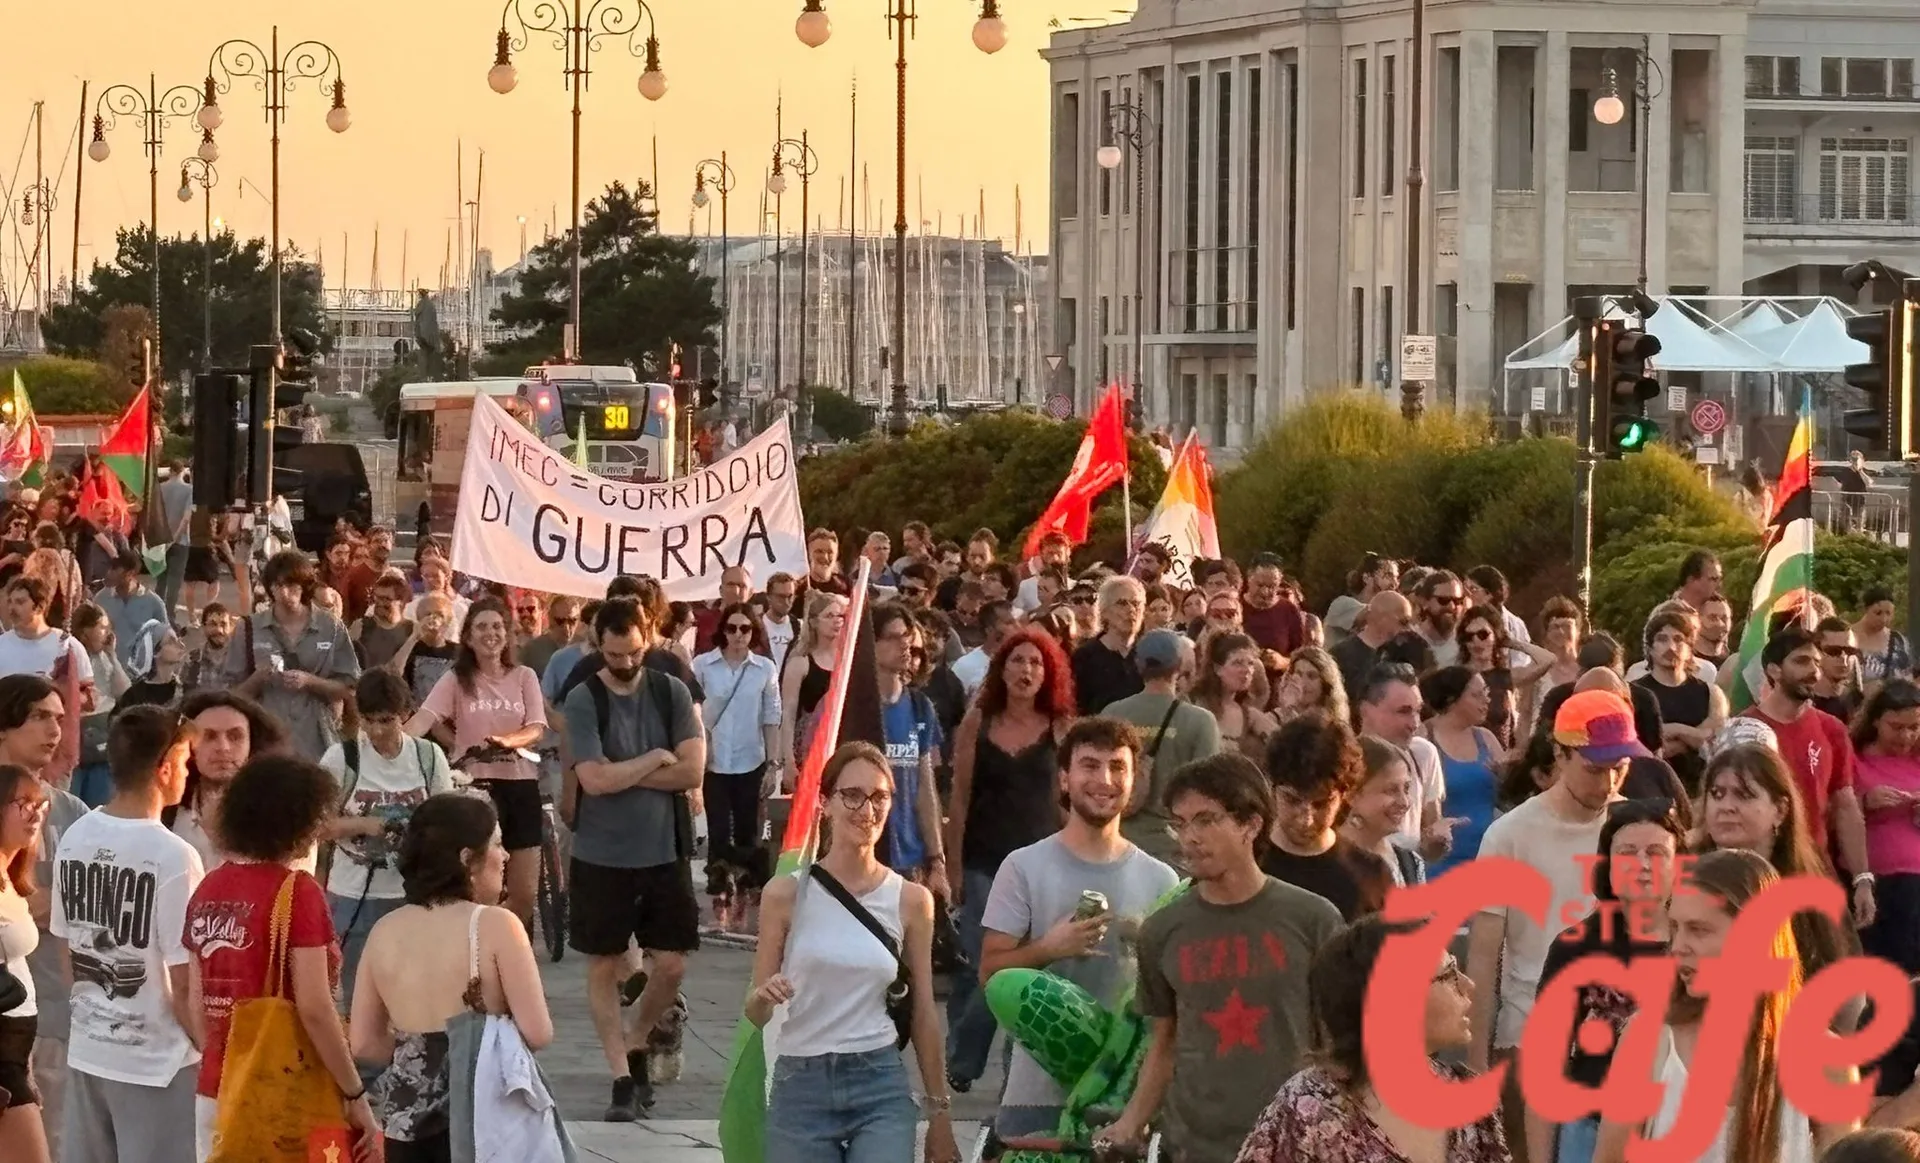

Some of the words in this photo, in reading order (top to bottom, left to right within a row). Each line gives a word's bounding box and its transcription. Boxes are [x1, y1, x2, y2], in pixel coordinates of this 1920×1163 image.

[604, 406, 629, 430] 30
[490, 424, 559, 487] IMEC
[599, 442, 788, 511] CORRIDOIO
[480, 484, 514, 527] DI
[532, 503, 777, 581] GUERRA
